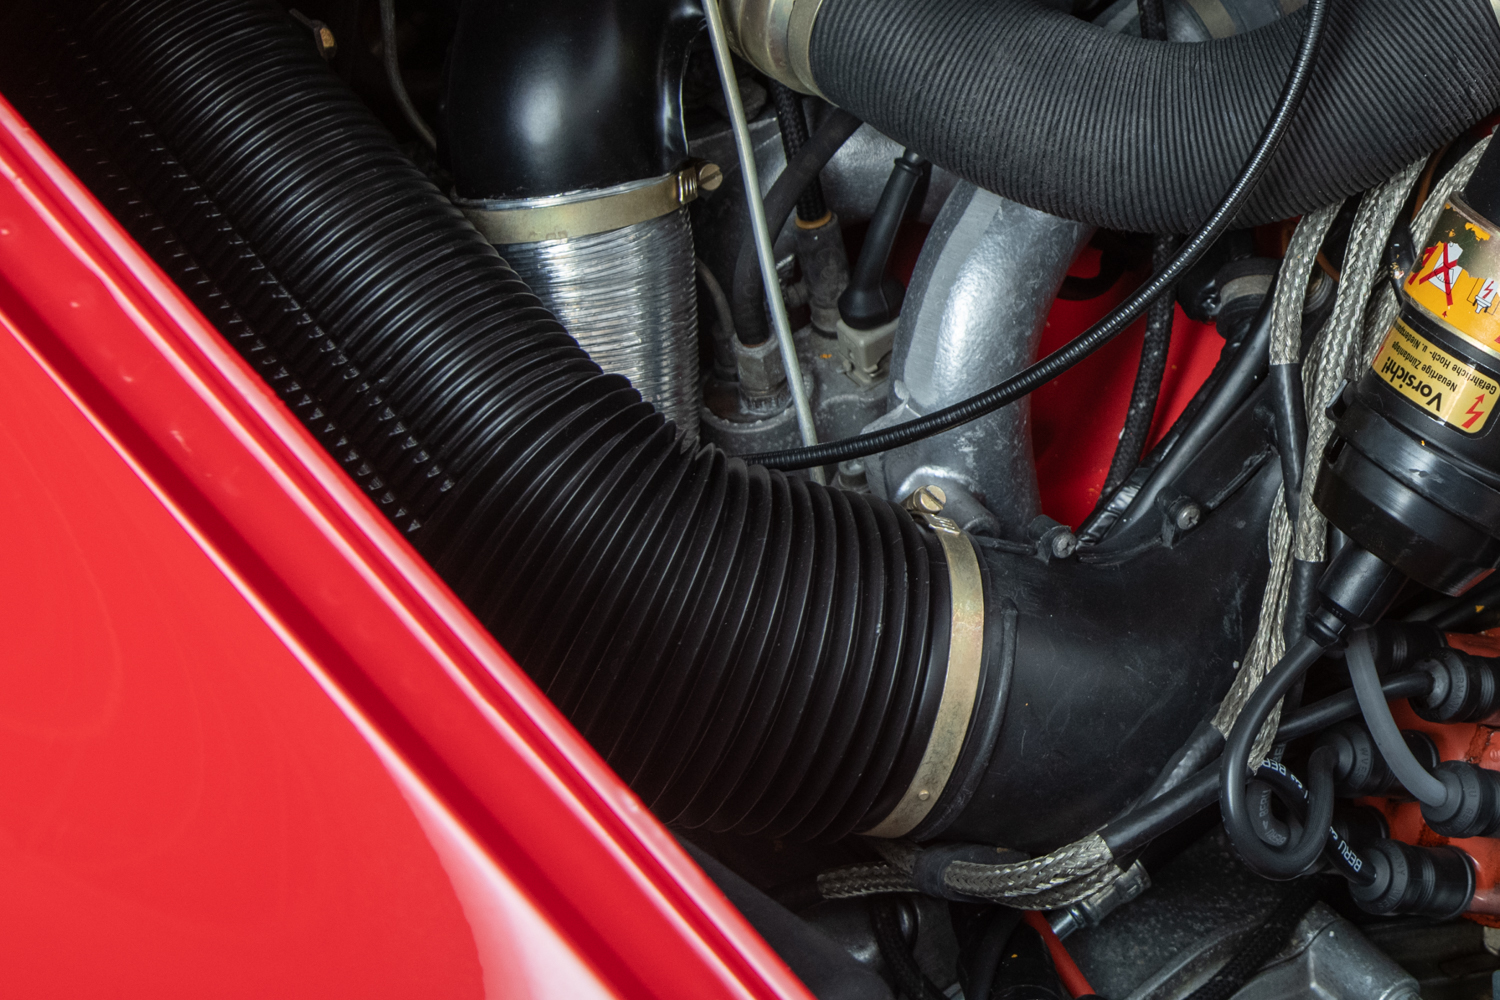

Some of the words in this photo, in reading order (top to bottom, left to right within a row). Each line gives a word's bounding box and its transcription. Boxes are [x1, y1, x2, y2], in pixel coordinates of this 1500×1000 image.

[1391, 340, 1422, 370] Zündanlage
[1429, 350, 1452, 370] Hoch-
[1381, 356, 1442, 412] Vorsicht!
[1421, 364, 1458, 393] Neuartige
[1451, 364, 1497, 395] Gefährliche
[1338, 840, 1363, 872] BERU
